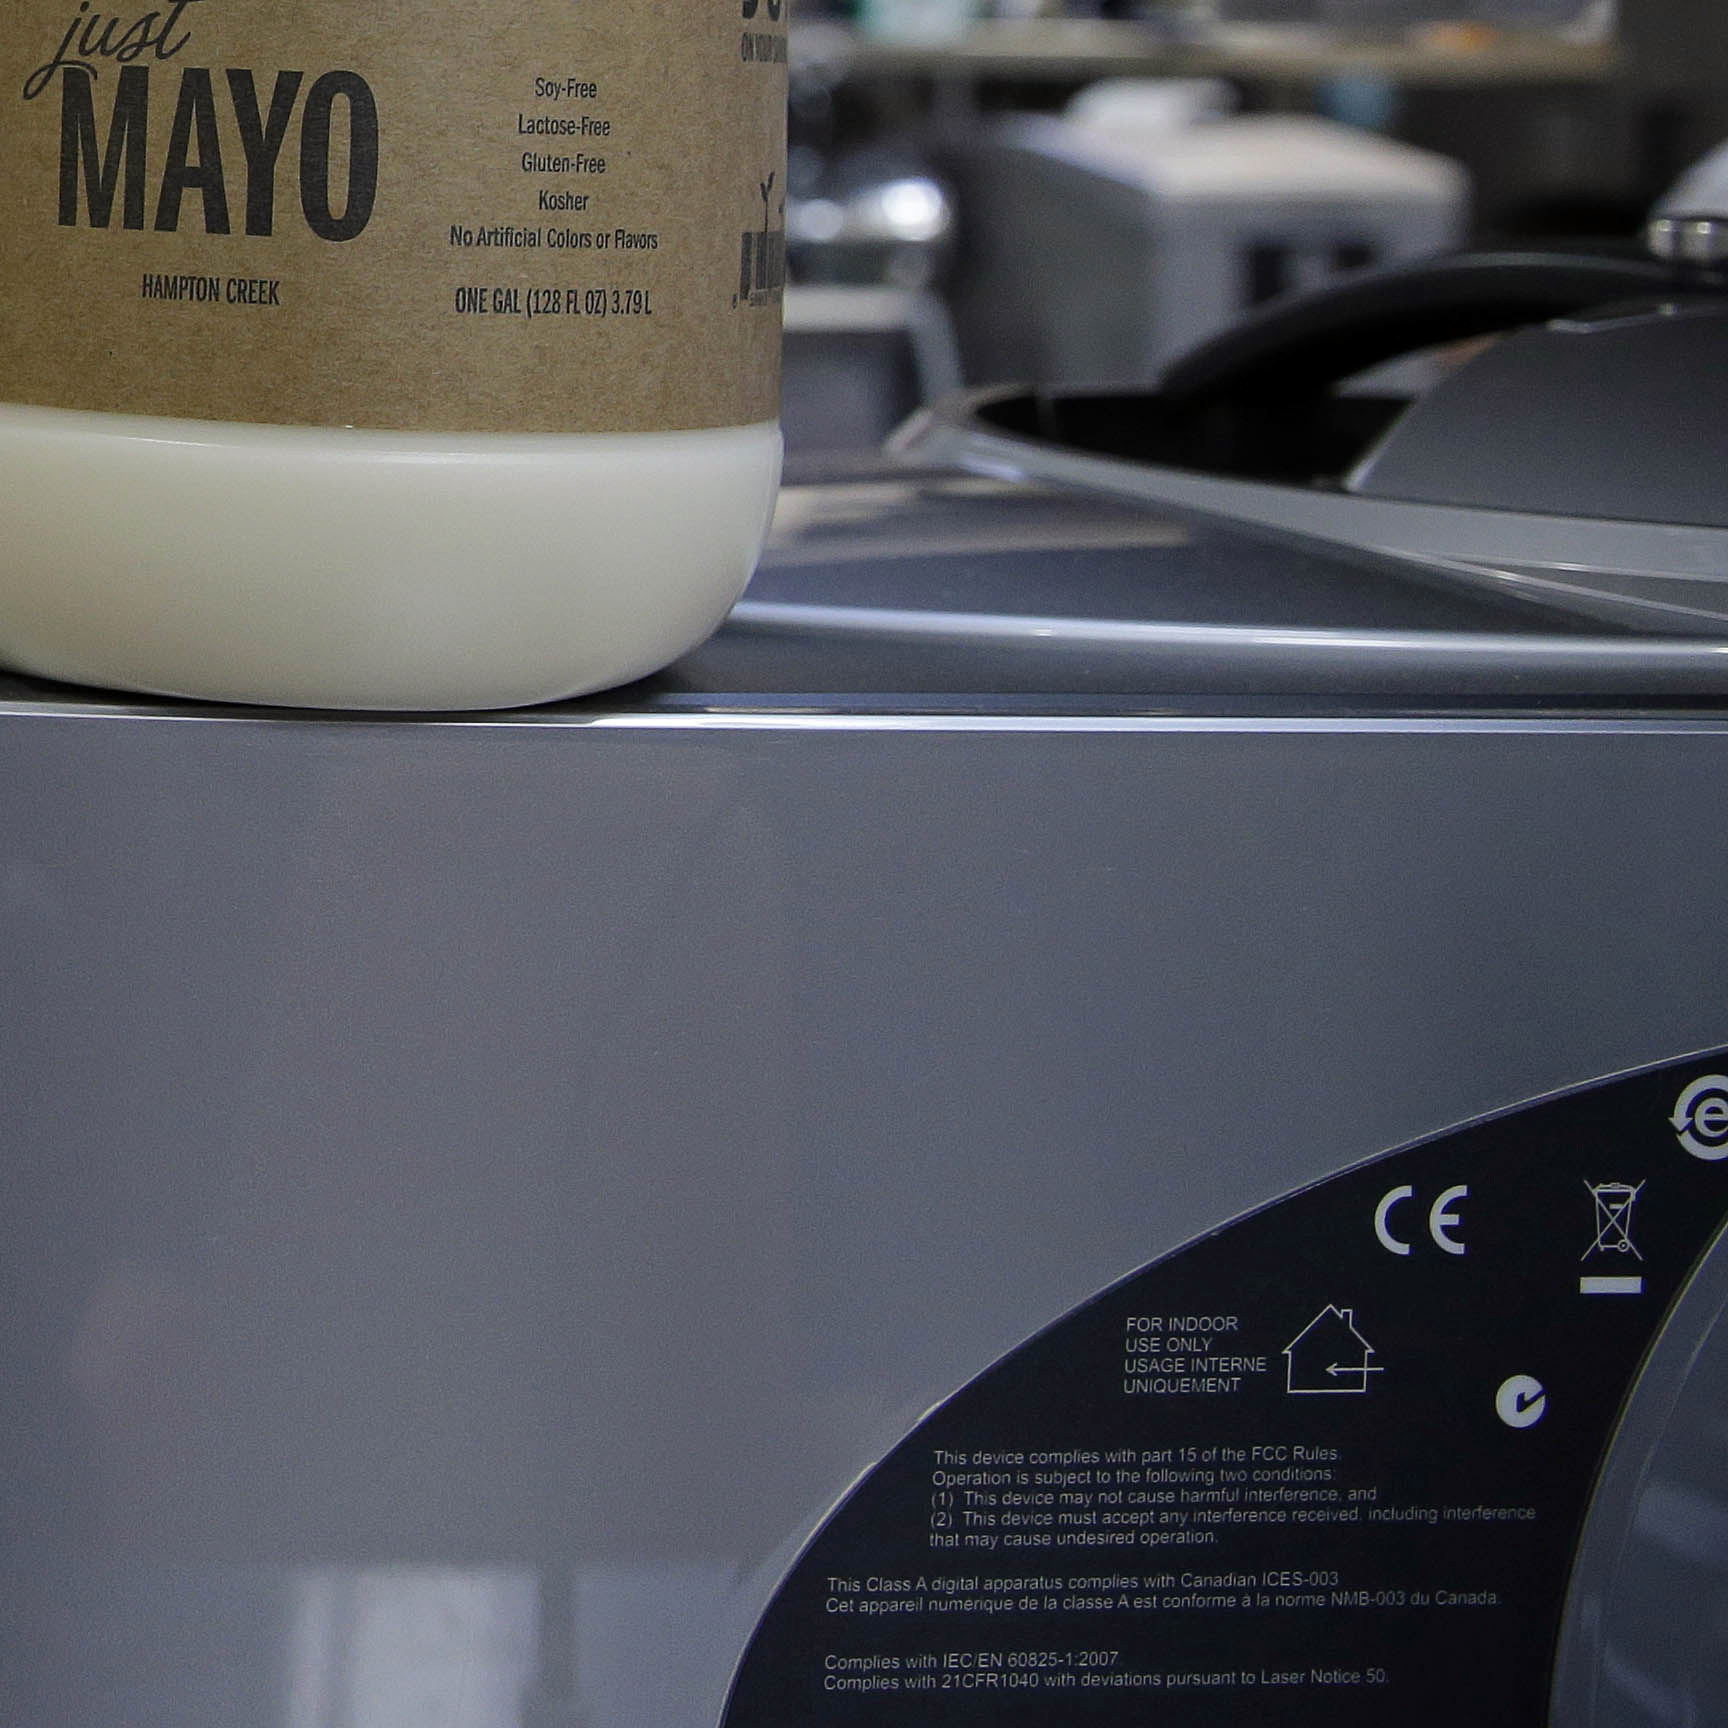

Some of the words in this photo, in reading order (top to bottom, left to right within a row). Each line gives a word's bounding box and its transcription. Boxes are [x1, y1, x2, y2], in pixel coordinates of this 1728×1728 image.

[535, 77, 597, 101] Soy-Free
[517, 113, 611, 136] Lactose-Free
[58, 65, 379, 242] MAYO
[521, 152, 606, 174] Gluten-Free
[538, 190, 590, 211] Kosher
[449, 225, 473, 247] No
[476, 227, 542, 248] Artificial
[546, 228, 593, 249] Colors
[596, 233, 611, 249] or
[614, 229, 659, 250] Flavors
[142, 274, 220, 302] HAMPTON
[226, 279, 280, 305] CREEK
[455, 287, 488, 313] ONE
[493, 288, 522, 314] GAL
[526, 289, 561, 318] (128
[566, 290, 581, 314] FL
[585, 289, 607, 317] OZ)
[611, 290, 642, 315] 3.79
[644, 291, 653, 315] L
[1126, 1317, 1163, 1332] FOR
[1168, 1316, 1239, 1331] INDOOR
[1125, 1337, 1161, 1352] USE
[1166, 1336, 1213, 1351] ONLY
[1124, 1358, 1186, 1373] USAGE
[1190, 1357, 1268, 1372] INTERNE
[1123, 1378, 1242, 1393] UNIQUEMENT
[932, 1450, 968, 1465] This
[971, 1449, 1025, 1464] device
[1028, 1448, 1101, 1467] complies
[1104, 1448, 1137, 1463] with
[1140, 1447, 1173, 1466] part
[1178, 1447, 1198, 1462] 15
[1201, 1447, 1218, 1462] of
[1221, 1446, 1247, 1461] the
[1251, 1446, 1288, 1461] FCC
[931, 1471, 1012, 1489] Operation
[1015, 1470, 1030, 1485] is
[1034, 1469, 1092, 1488] subject
[1095, 1469, 1112, 1484] to
[1115, 1469, 1141, 1484] the
[1145, 1468, 1215, 1487] following
[1219, 1467, 1248, 1482] two
[931, 1491, 954, 1510] (1)
[964, 1491, 997, 1506] This
[1002, 1490, 1054, 1505] device
[1059, 1493, 1092, 1508] may
[1098, 1489, 1123, 1504] not
[1128, 1492, 1175, 1504] cause
[1180, 1488, 1239, 1503] harmful
[1348, 1486, 1376, 1501] and
[930, 1512, 953, 1530] (2)
[962, 1511, 997, 1526] This
[1000, 1511, 1054, 1526] device
[1058, 1510, 1097, 1525] must
[1101, 1509, 1155, 1528] accept
[1159, 1512, 1189, 1527] any
[1193, 1508, 1287, 1523] interference
[1368, 1506, 1438, 1525] including
[1443, 1505, 1535, 1520] interference
[930, 1532, 959, 1547] that
[964, 1535, 997, 1550] may
[1004, 1534, 1051, 1546] cause
[1057, 1530, 1134, 1545] undesired
[1140, 1529, 1219, 1548] operation.
[826, 1577, 861, 1592] This
[866, 1577, 912, 1592] Class
[915, 1576, 928, 1591] A
[931, 1576, 979, 1594] digital
[983, 1575, 1063, 1593] apparatus
[1068, 1574, 1139, 1592] complies
[1143, 1573, 1176, 1588] with
[1180, 1572, 1257, 1587] Canadian
[1262, 1571, 1339, 1586] ICES-003
[825, 1597, 855, 1612] Cet
[858, 1597, 924, 1615] appareil
[1018, 1595, 1039, 1610] de
[1043, 1595, 1058, 1610] la
[1062, 1595, 1114, 1610] classe
[1116, 1594, 1130, 1609] A
[1132, 1594, 1158, 1609] est
[1161, 1593, 1237, 1608] conforme
[1256, 1593, 1271, 1608] la
[1275, 1595, 1326, 1607] norme
[1331, 1592, 1406, 1607] NMB-003
[1410, 1591, 1430, 1606] du
[824, 1654, 901, 1672] Complies
[904, 1653, 938, 1668] with
[1007, 1651, 1119, 1666] 60825-1:2007
[823, 1674, 900, 1693] Complies
[903, 1674, 937, 1689] with
[941, 1673, 1040, 1688] 21CFR1040
[1043, 1672, 1076, 1687] with
[1080, 1672, 1162, 1687] deviations
[1166, 1671, 1236, 1689] pursuant
[1240, 1670, 1256, 1685] to
[1260, 1670, 1306, 1685] Laser
[1310, 1669, 1361, 1684] Notice
